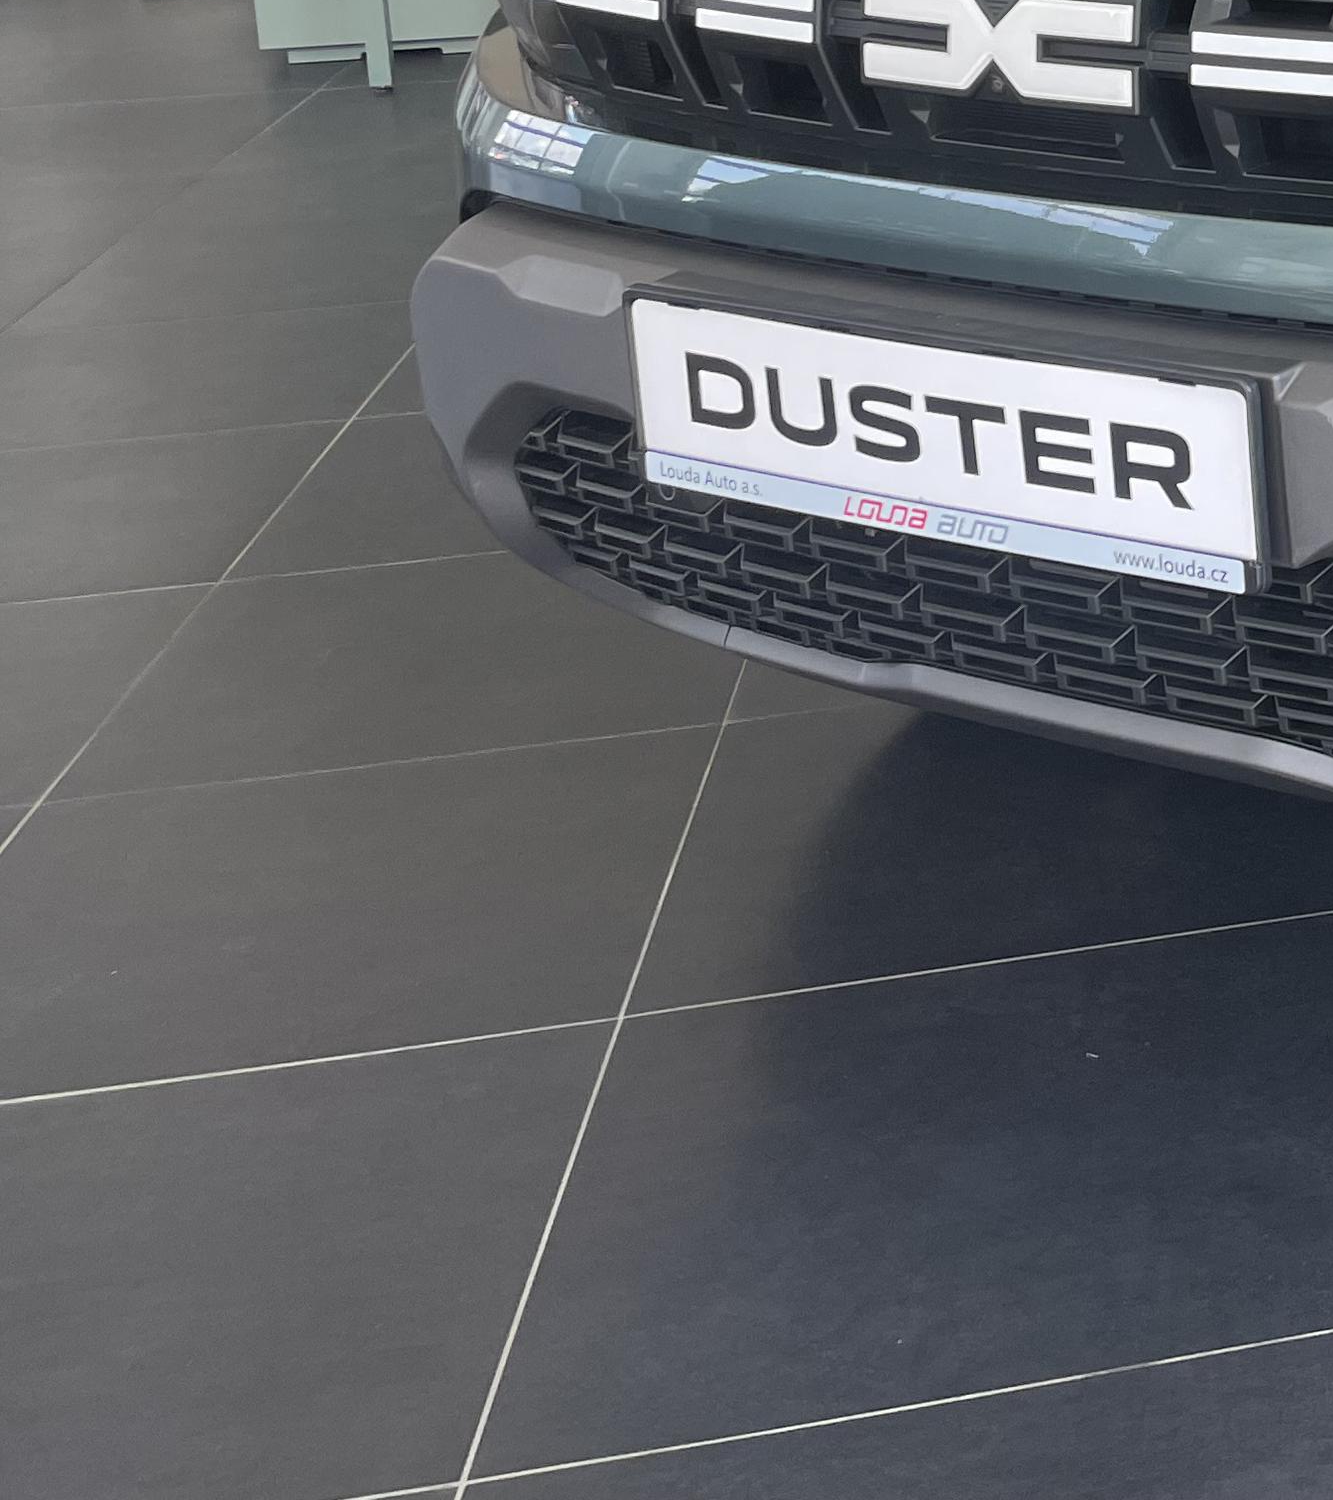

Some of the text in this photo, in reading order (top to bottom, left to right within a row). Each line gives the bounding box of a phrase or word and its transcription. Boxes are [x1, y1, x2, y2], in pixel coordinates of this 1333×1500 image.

[684, 350, 1194, 511] DUSTER
[659, 460, 763, 496] Louda Auto a.s.
[1113, 549, 1229, 584] www.louda.cz
